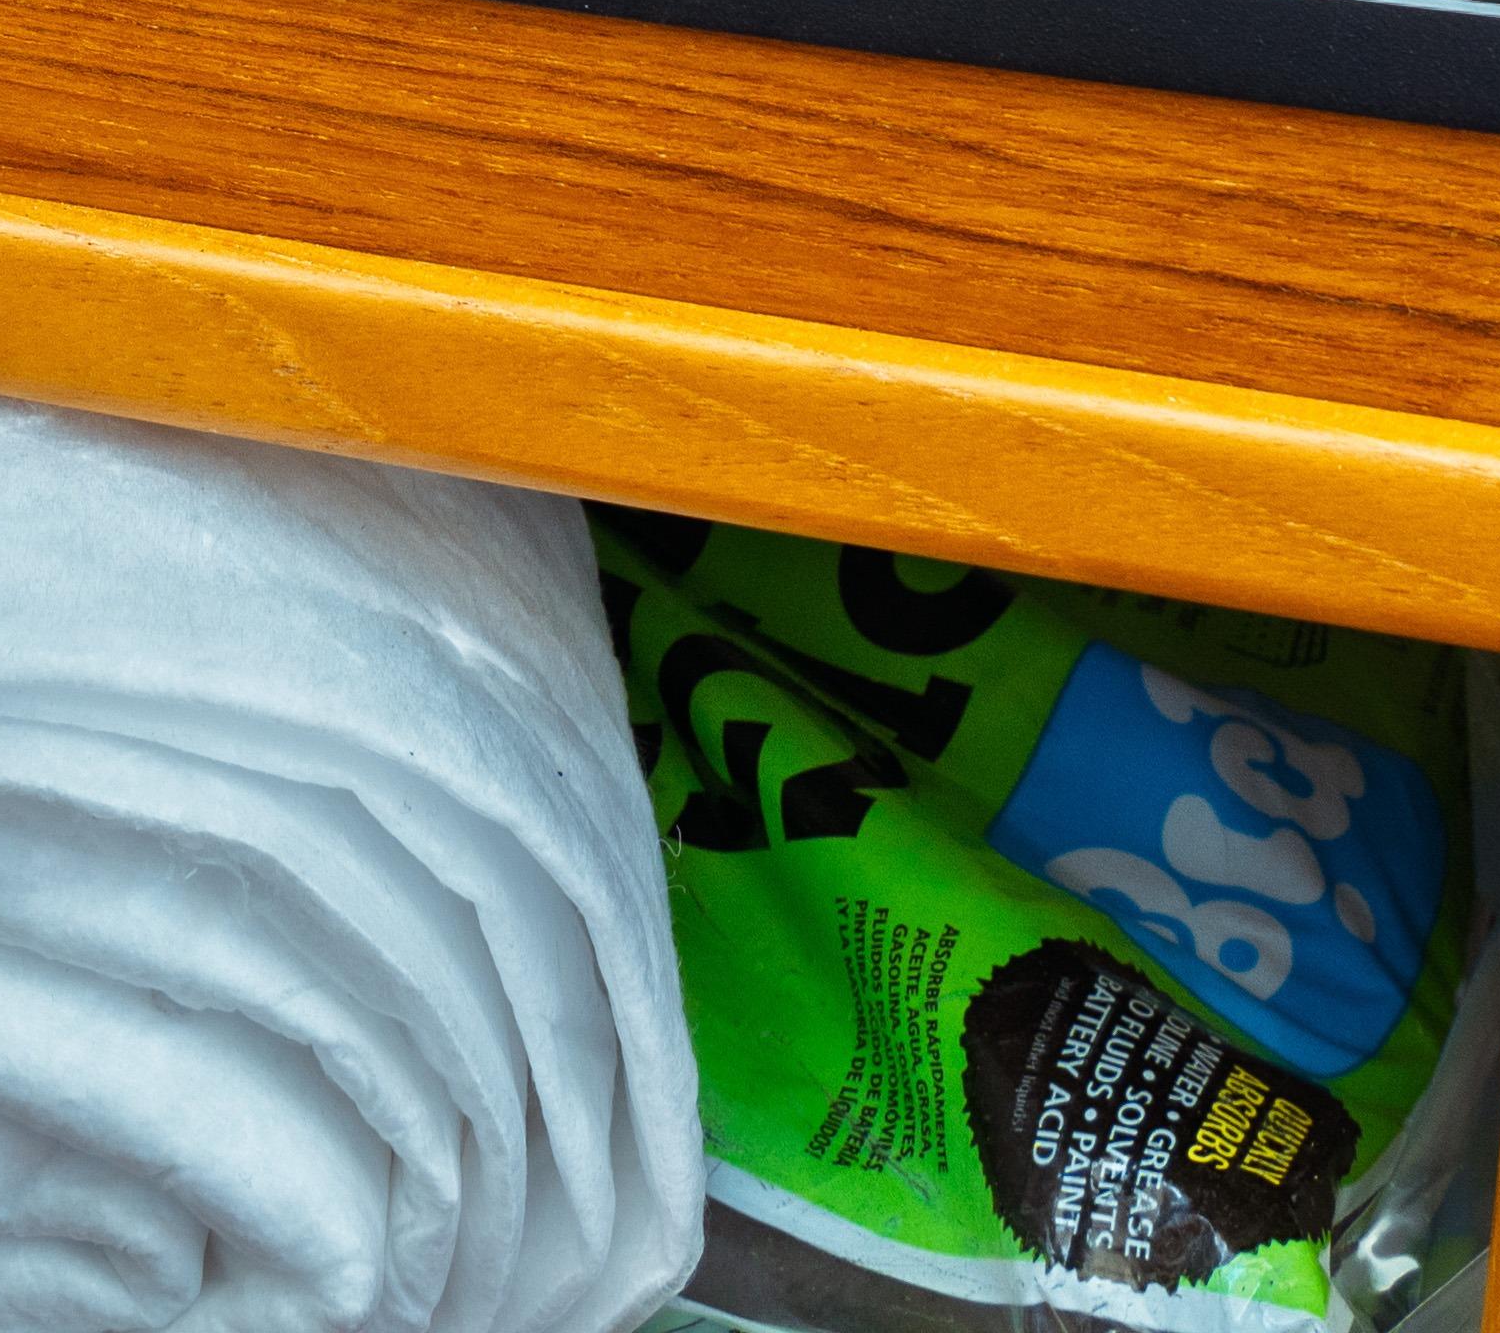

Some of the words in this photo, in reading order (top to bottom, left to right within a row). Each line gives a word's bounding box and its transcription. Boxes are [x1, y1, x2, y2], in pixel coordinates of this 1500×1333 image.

[869, 906, 890, 994] FLUIDOS
[904, 927, 932, 1002] ACEITE,
[923, 922, 961, 1013] ABSORBE
[837, 924, 852, 951] LA
[846, 1056, 867, 1082] DE
[904, 1006, 924, 1074] AGUA,
[1056, 973, 1123, 1079] BATTERY
[866, 1072, 885, 1101] DE
[1085, 1015, 1145, 1101] FLUIDS
[1169, 1039, 1225, 1109] WATER
[914, 1078, 933, 1159] GRASA,
[1031, 1082, 1071, 1166] ACID
[1187, 1064, 1271, 1171] ABSORBS
[1239, 1096, 1314, 1186] QUICKLY
[1054, 1129, 1097, 1236] PAINT
[1087, 1085, 1153, 1250] SOLVENTS
[1124, 1127, 1178, 1262] GREASE
